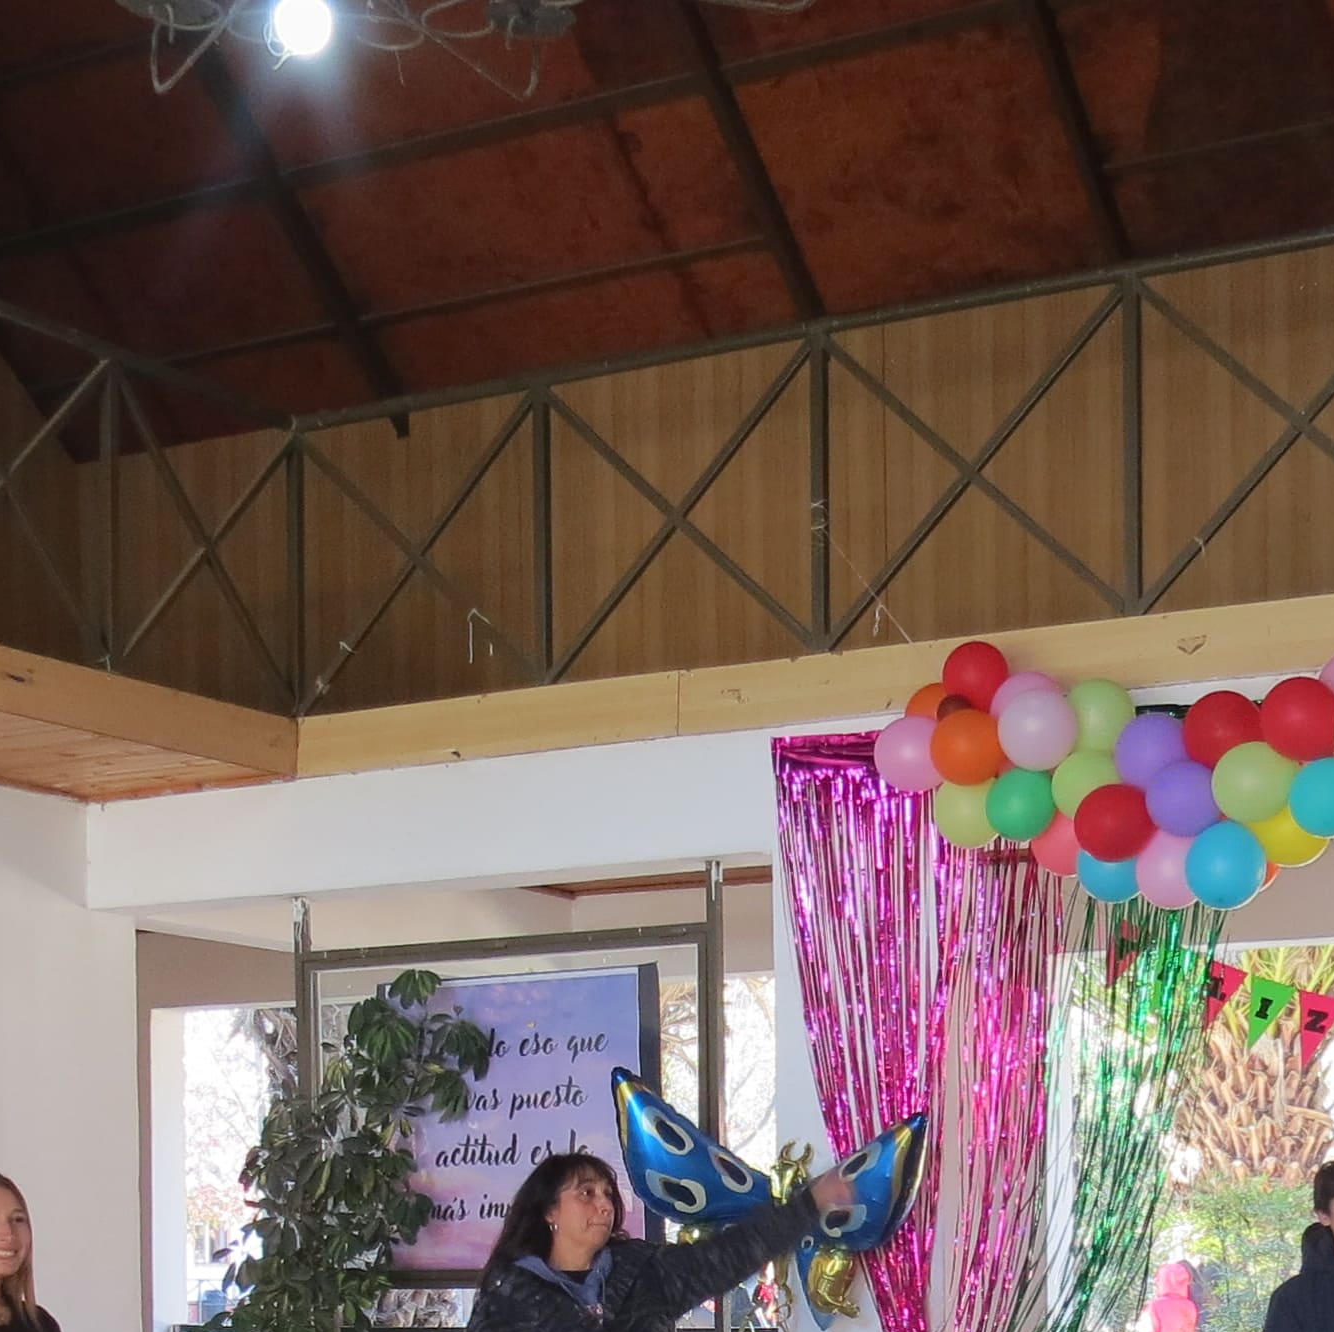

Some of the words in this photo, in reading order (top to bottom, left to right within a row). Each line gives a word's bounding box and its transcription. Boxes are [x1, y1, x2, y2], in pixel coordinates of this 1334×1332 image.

[519, 1032, 558, 1056] eso
[567, 1032, 609, 1064] que
[508, 1075, 588, 1120] puesto
[435, 1133, 522, 1168] actitud
